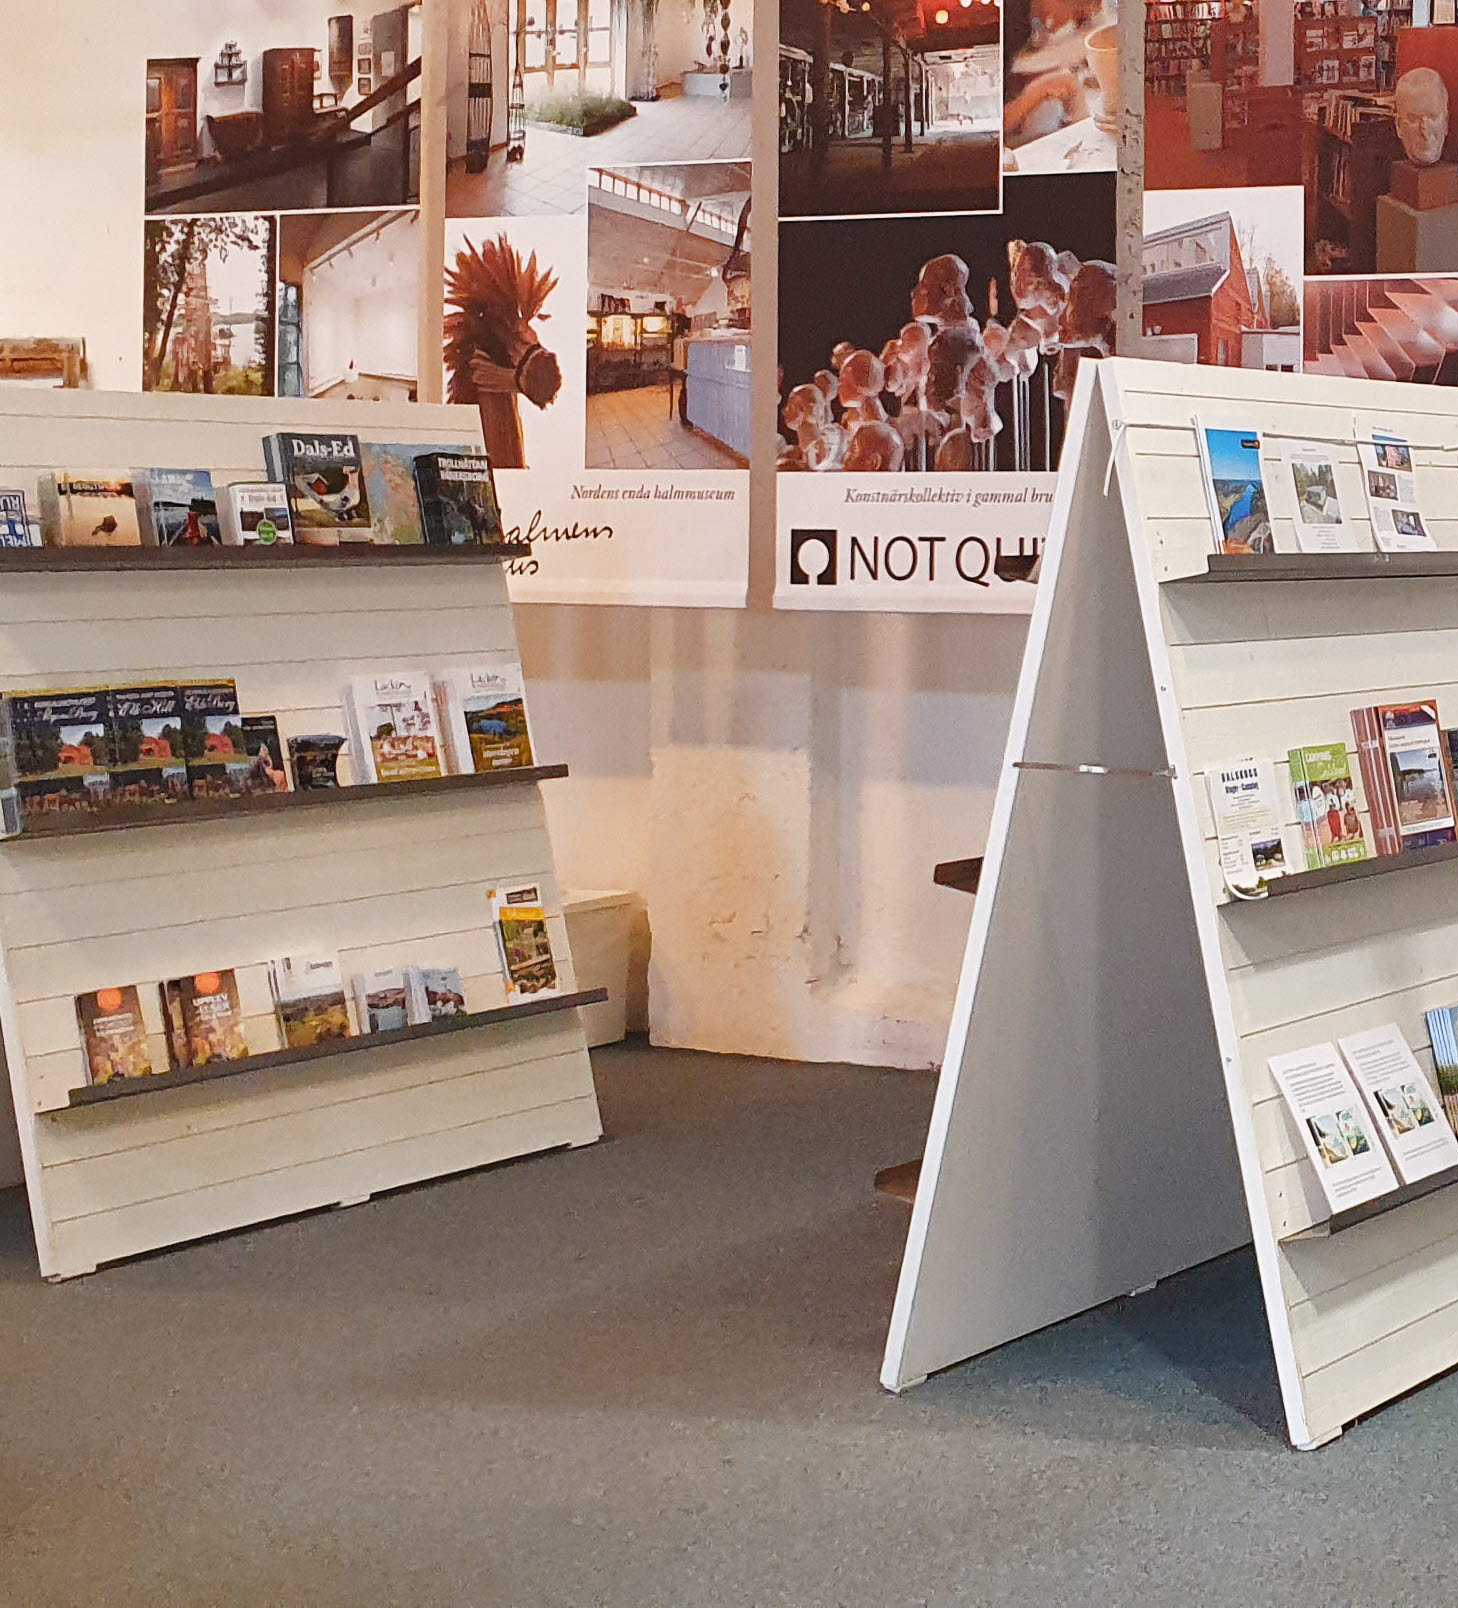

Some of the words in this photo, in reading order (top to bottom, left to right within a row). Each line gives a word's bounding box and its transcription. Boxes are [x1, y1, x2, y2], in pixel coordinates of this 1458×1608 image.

[292, 439, 355, 459] Dals-Ed
[571, 484, 619, 500] Nordens
[622, 485, 651, 500] enda
[654, 484, 735, 501] halmmuseum
[844, 487, 964, 504] Konstnärskollektiv
[965, 488, 972, 504] i
[973, 487, 1028, 508] gammal
[1031, 488, 1054, 504] bru
[503, 510, 614, 544] almens
[505, 558, 540, 576] us
[850, 536, 946, 581] NOT
